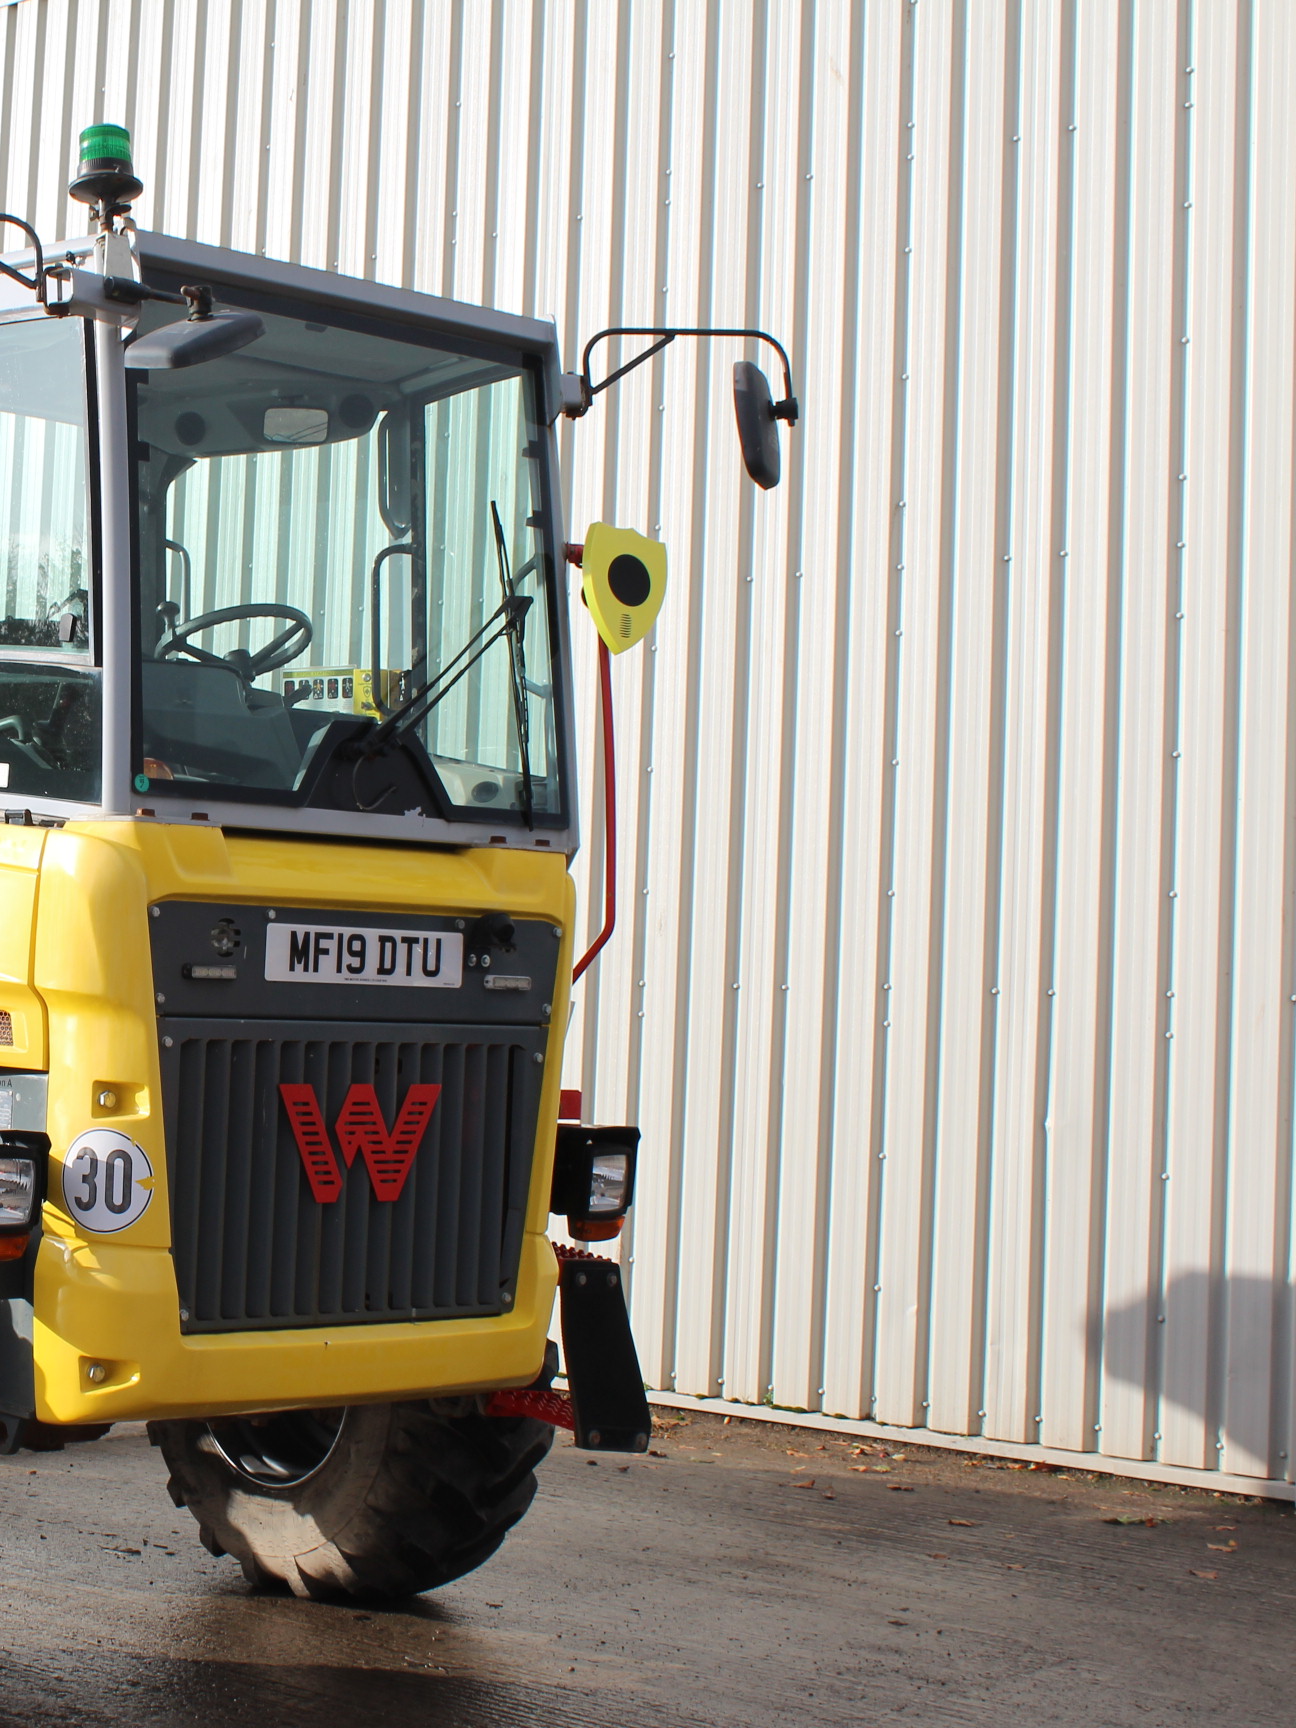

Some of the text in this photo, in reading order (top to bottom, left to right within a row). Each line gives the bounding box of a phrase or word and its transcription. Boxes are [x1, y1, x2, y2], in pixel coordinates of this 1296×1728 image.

[289, 930, 442, 978] MF19 DTU
[7, 1078, 13, 1088] A
[73, 1146, 133, 1214] 30
